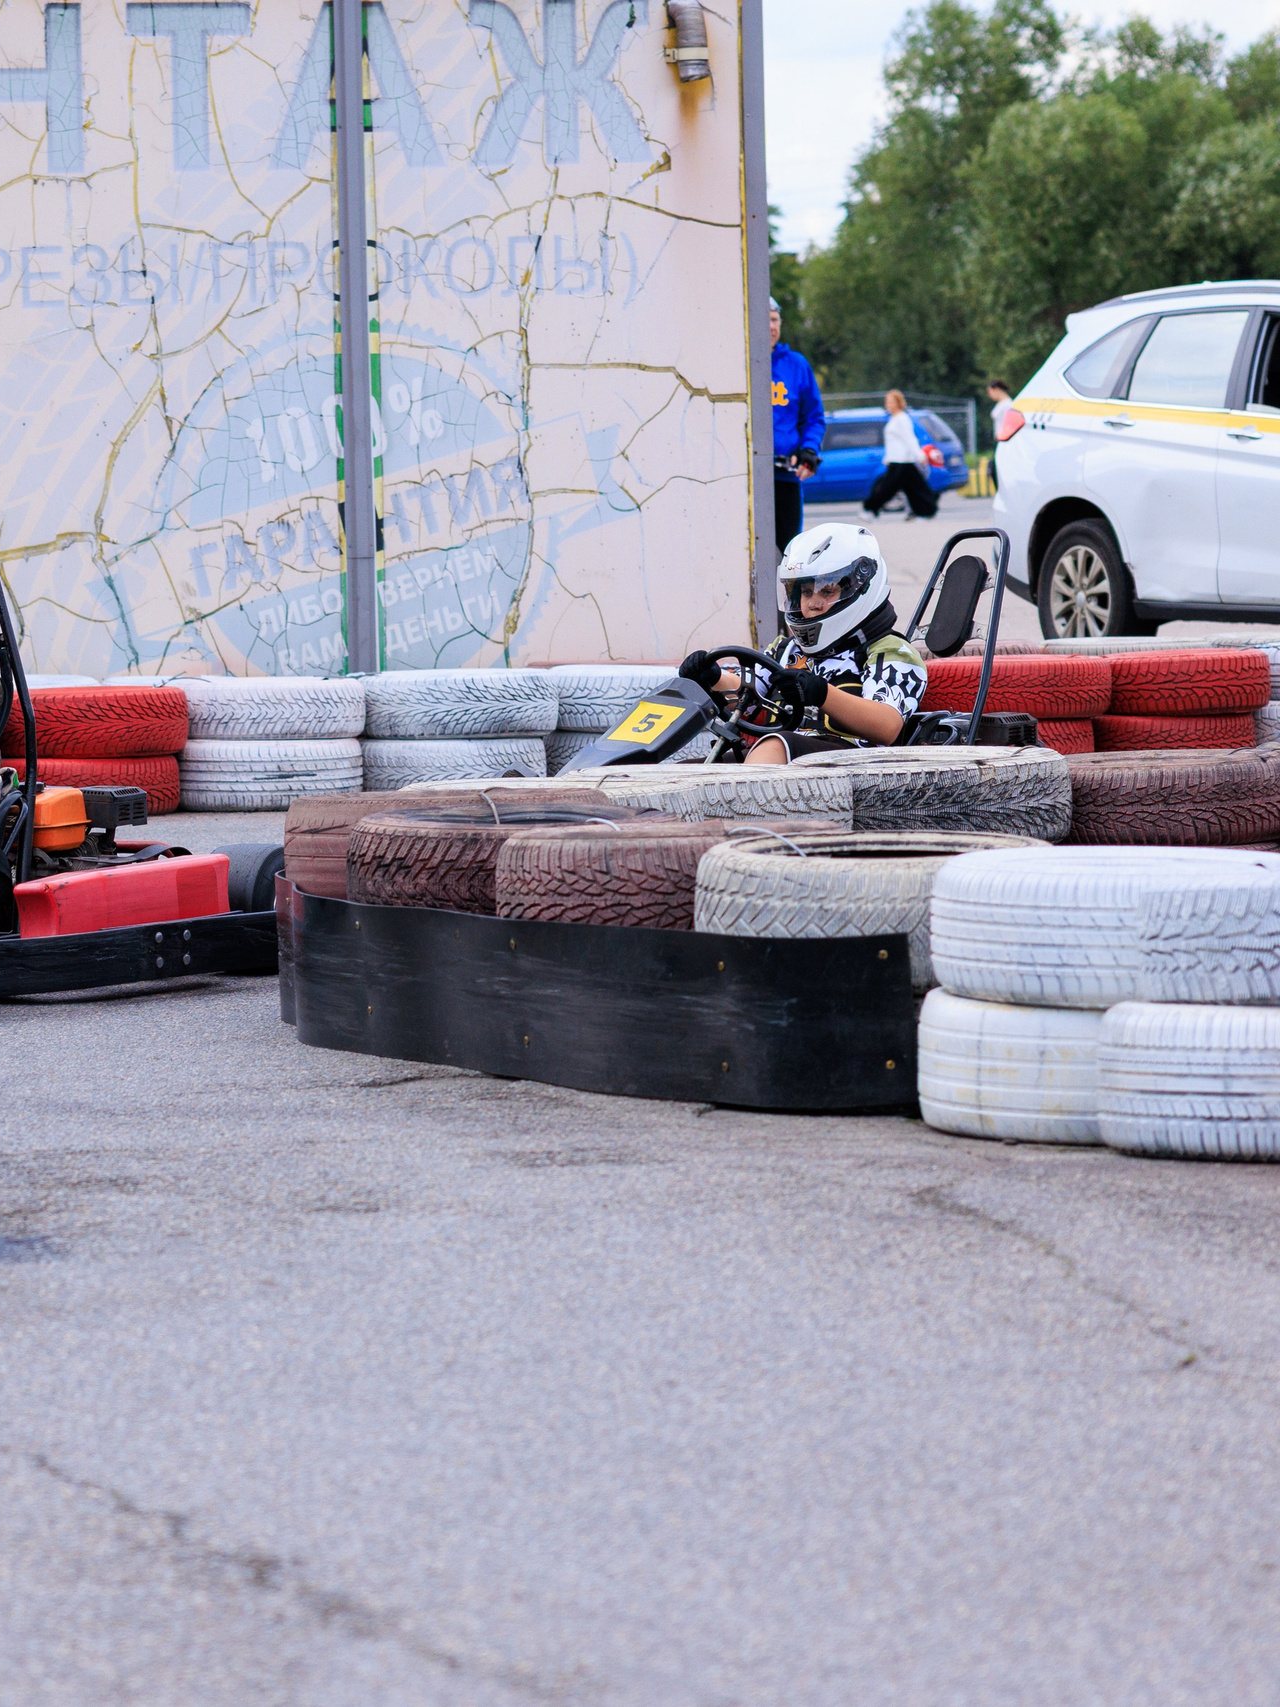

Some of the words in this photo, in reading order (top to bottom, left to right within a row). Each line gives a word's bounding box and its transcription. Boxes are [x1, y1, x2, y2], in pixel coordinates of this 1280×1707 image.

[187, 455, 531, 599] ГАРАНТИЯ
[257, 587, 344, 639] ЛИБО
[277, 631, 349, 677] ВАМ
[385, 590, 502, 656] ДЕНЬГИ
[632, 713, 664, 733] 5
